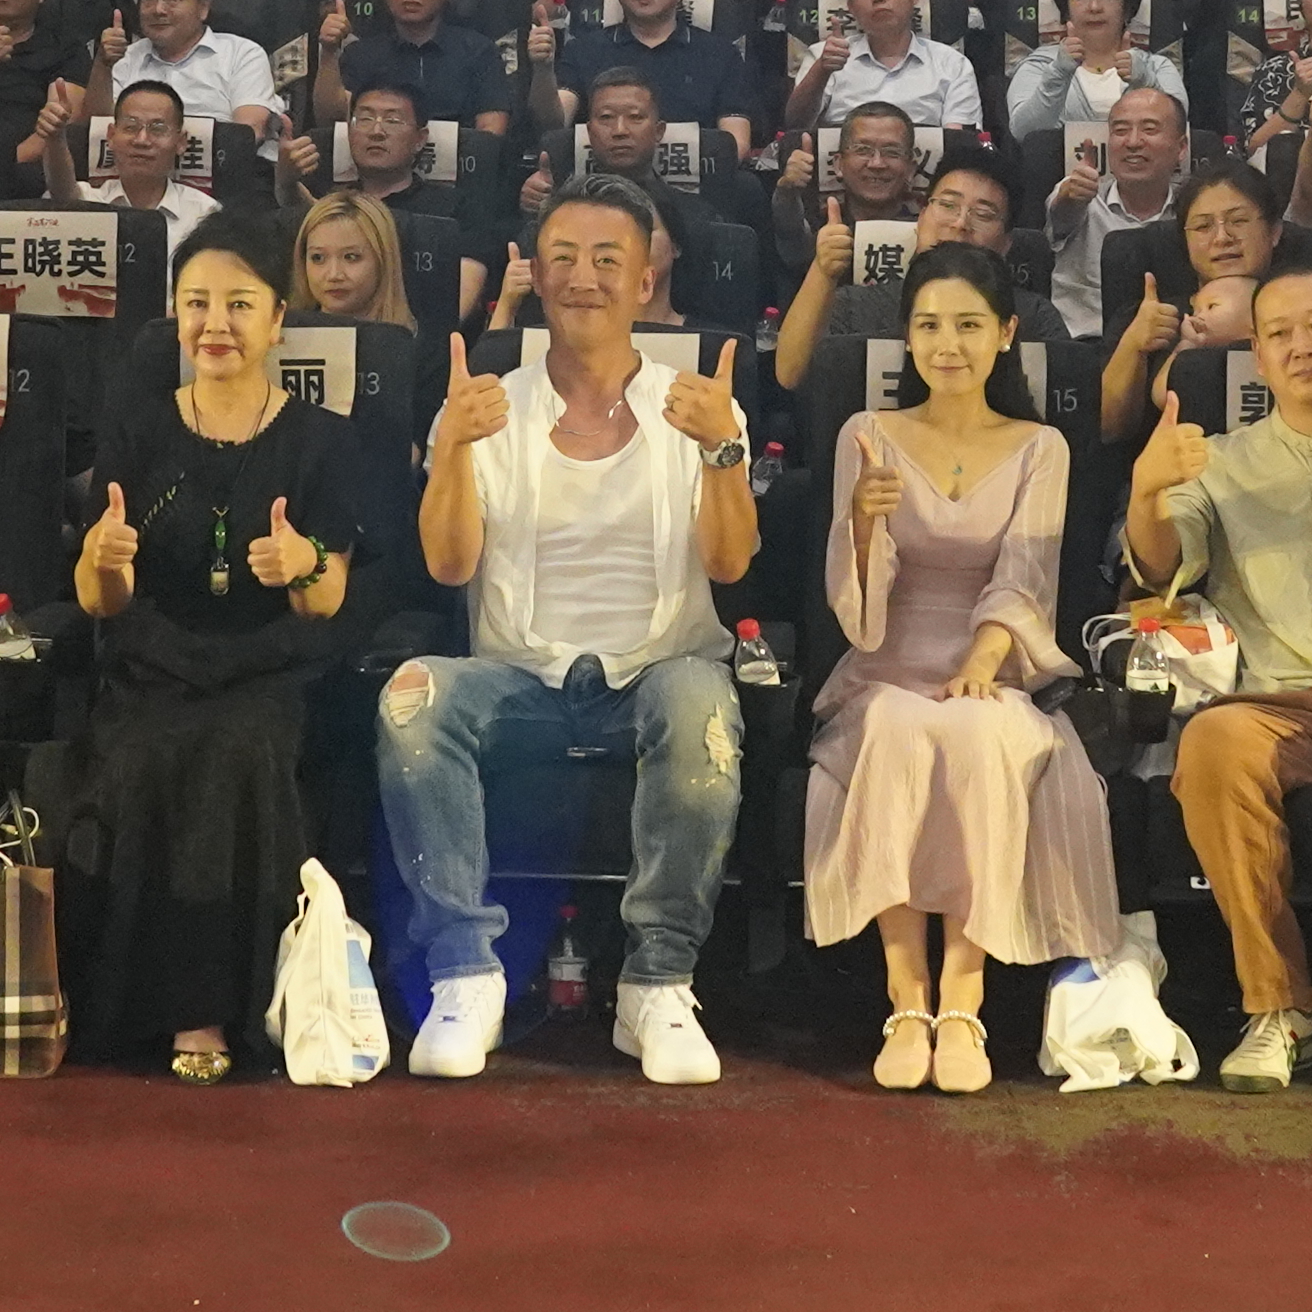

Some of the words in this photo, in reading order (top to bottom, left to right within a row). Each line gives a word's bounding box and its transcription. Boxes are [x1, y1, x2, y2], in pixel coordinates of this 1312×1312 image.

[354, 1, 373, 16] 10
[799, 9, 818, 23] 12
[1017, 6, 1036, 20] 13
[1238, 8, 1258, 23] 14
[413, 250, 434, 272] 13
[712, 260, 734, 282] 14
[864, 243, 905, 283] 媒
[279, 358, 327, 407] 丽
[1054, 388, 1078, 414] 15
